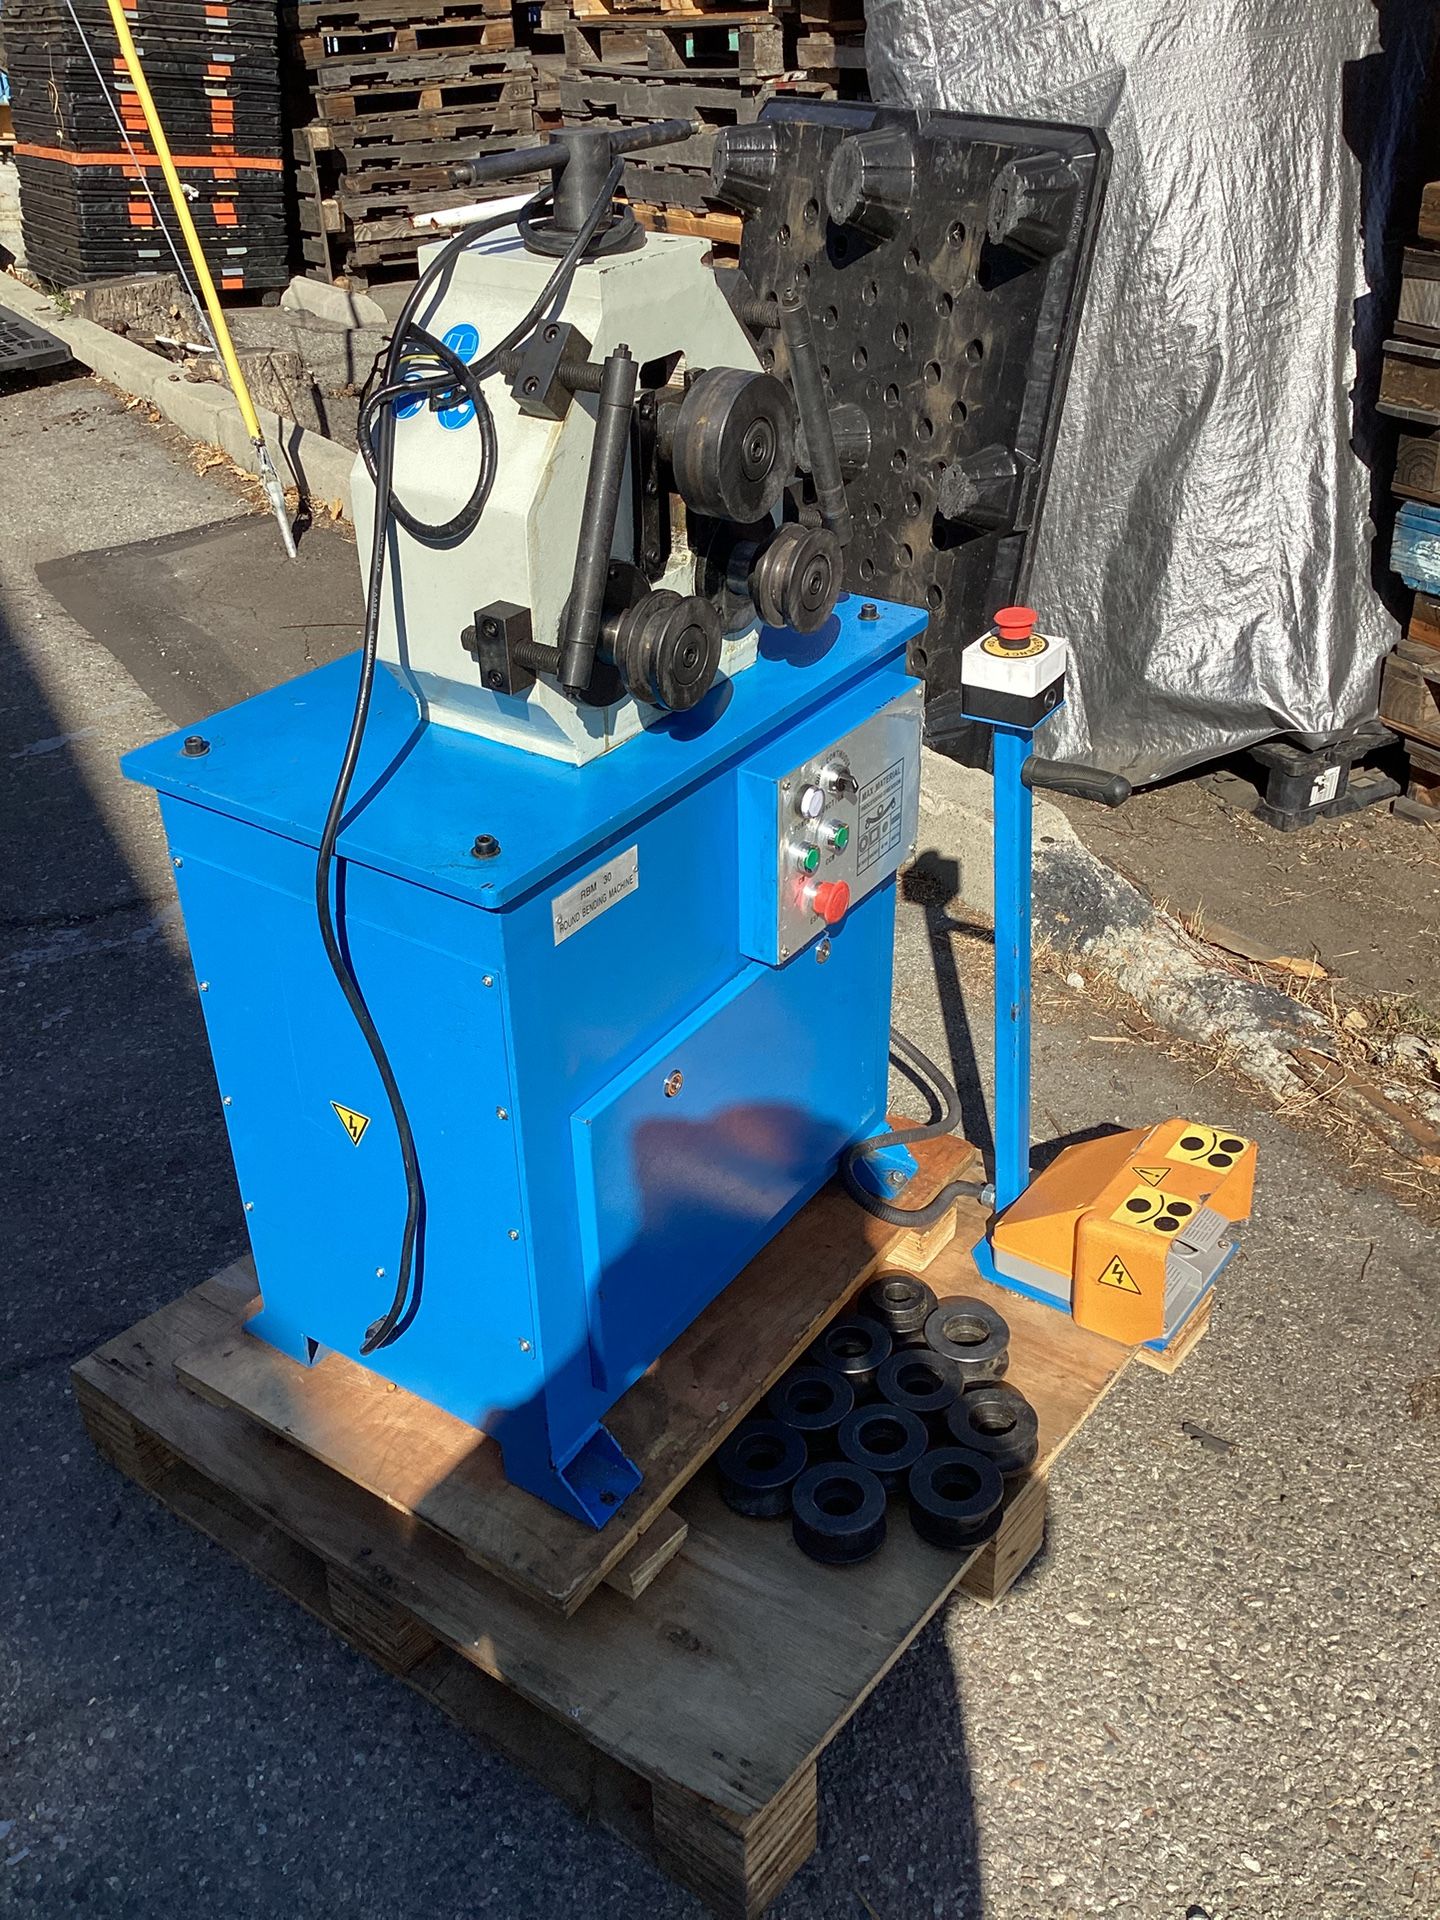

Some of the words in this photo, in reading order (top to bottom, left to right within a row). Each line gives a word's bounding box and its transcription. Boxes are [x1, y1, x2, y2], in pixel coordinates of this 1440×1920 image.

[559, 911, 581, 934] ROUND
[582, 893, 607, 918] BENDING
[608, 874, 634, 899] MACHINE
[580, 881, 598, 900] RBM
[603, 872, 612, 885] 30
